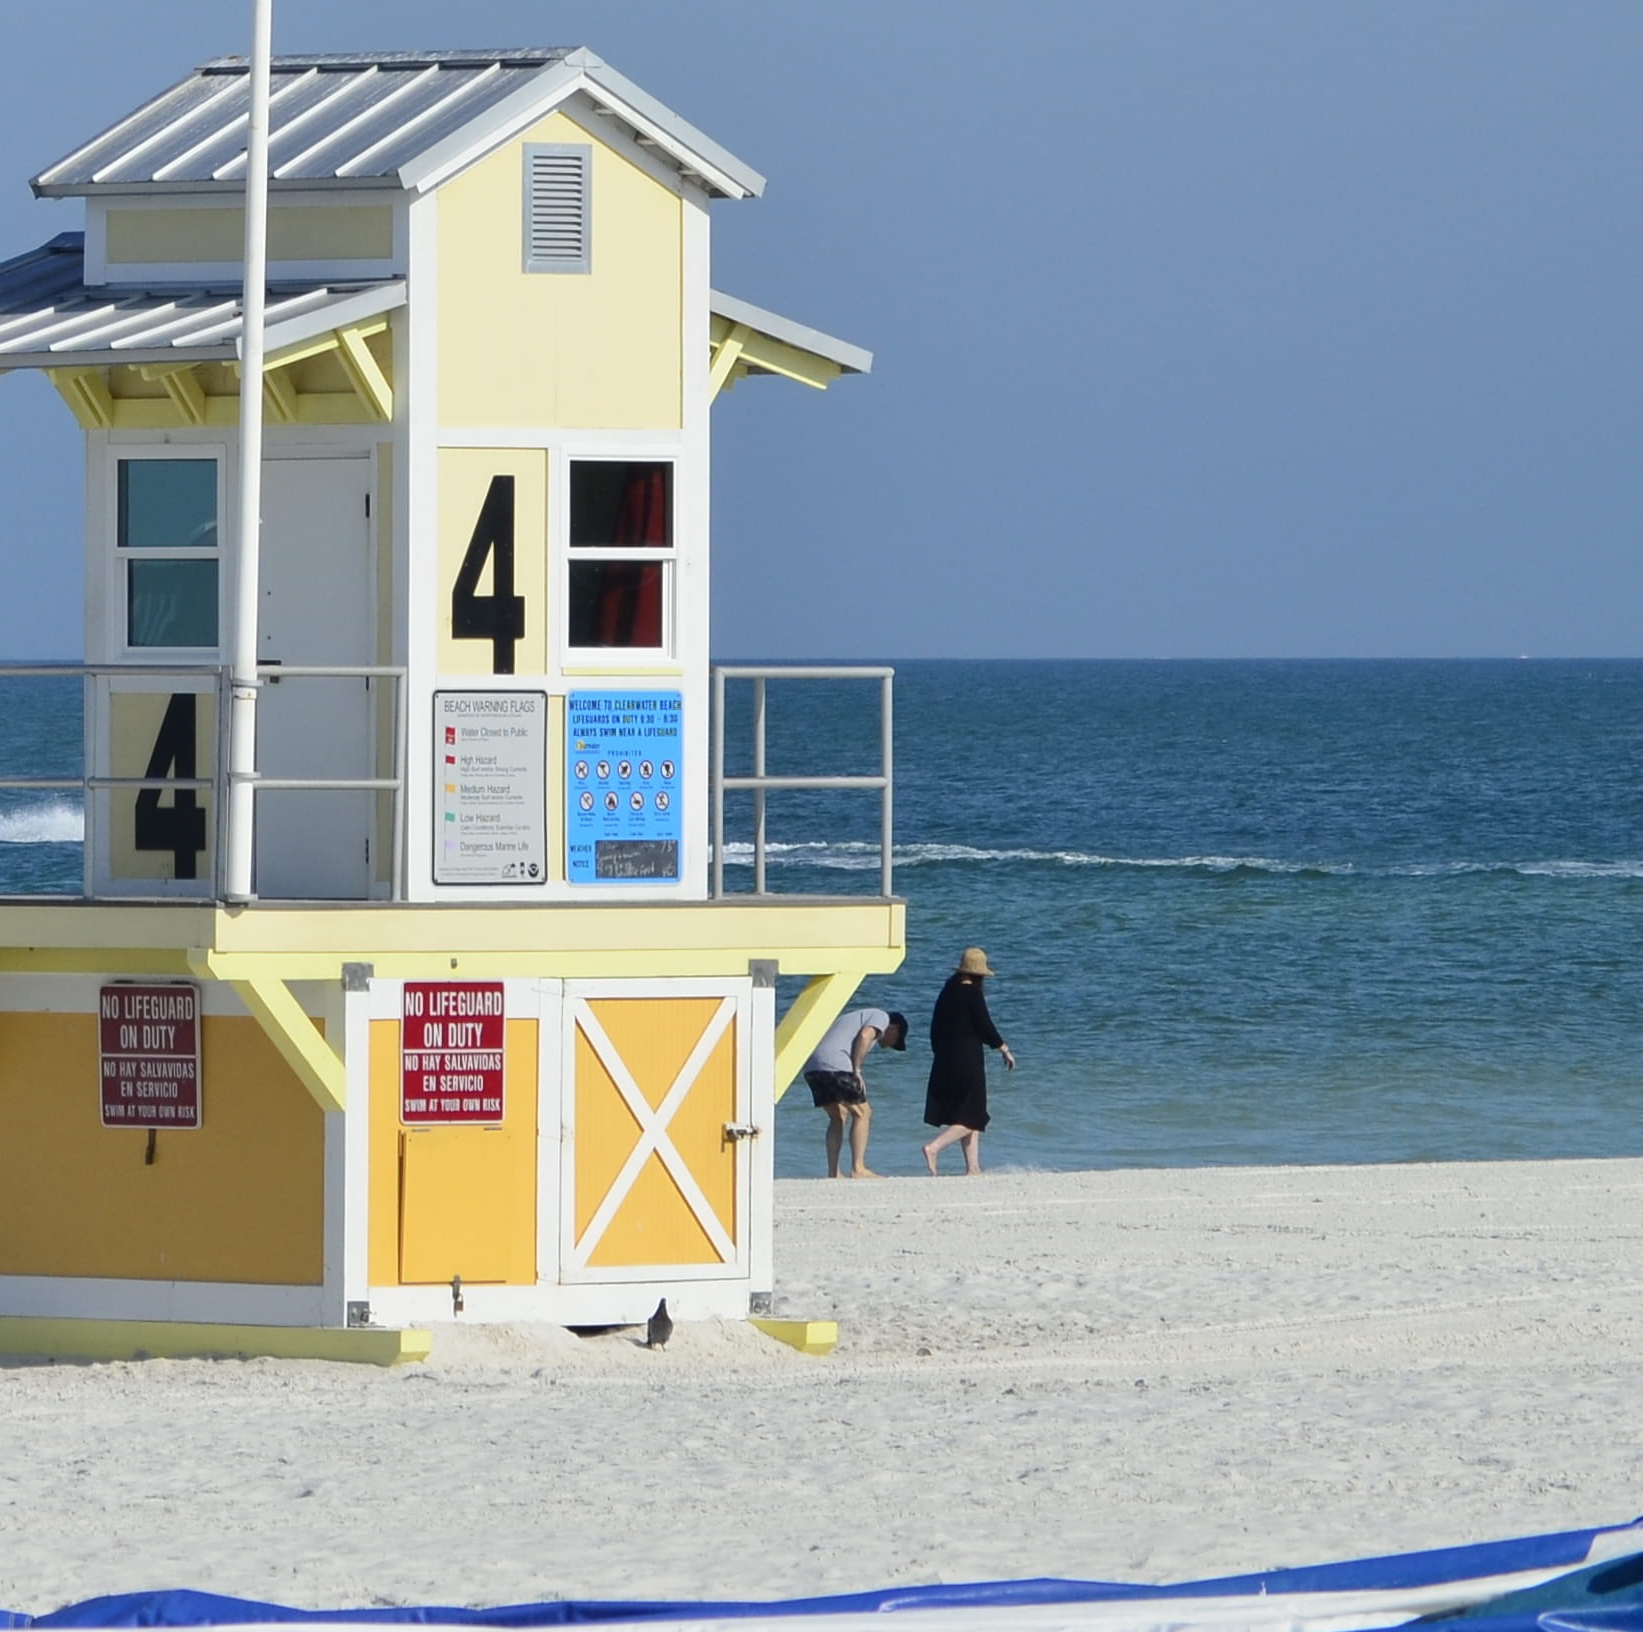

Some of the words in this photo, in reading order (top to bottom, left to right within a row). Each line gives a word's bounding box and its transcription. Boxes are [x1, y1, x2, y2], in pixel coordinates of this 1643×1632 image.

[452, 475, 525, 675] 4
[444, 700, 471, 712] BEACH
[472, 700, 508, 712] WARNING
[510, 700, 535, 712] FLAGS
[569, 700, 601, 711] WELCOME
[604, 700, 612, 711] TO
[614, 700, 657, 711] CLEARWATER
[660, 700, 681, 711] BEACH
[573, 715, 609, 724] LIFEGUARDS
[612, 715, 620, 724] ON
[622, 715, 638, 724] DUTY
[573, 728, 597, 736] ALWAYS
[599, 728, 617, 736] SWIM
[619, 728, 635, 736] NEAR
[638, 728, 642, 736] A
[644, 728, 677, 736] LIFEGUARD
[135, 693, 206, 879] 4
[102, 995, 119, 1019] NO
[125, 995, 193, 1020] LIFEGUARD
[405, 992, 424, 1016] NO
[429, 992, 502, 1016] LIFEGUARD
[120, 1025, 137, 1049] ON
[143, 1025, 175, 1049] DUTY
[424, 1023, 442, 1047] ON
[448, 1023, 483, 1047] DUTY
[103, 1061, 116, 1077] NO
[119, 1062, 137, 1078] HAY
[140, 1062, 194, 1079] SALVAVIDAS
[405, 1054, 419, 1071] NO
[422, 1054, 441, 1071] HAY
[444, 1054, 501, 1071] SALVAVIDAS
[121, 1082, 133, 1097] EN
[136, 1082, 178, 1098] SERVICIO
[423, 1075, 436, 1092] EN
[440, 1075, 484, 1092] SERVICIO
[105, 1105, 125, 1117] SWIM
[127, 1106, 136, 1117] AT
[138, 1106, 156, 1117] YOUR
[159, 1106, 176, 1118] OWN
[178, 1106, 195, 1118] RISK
[405, 1098, 426, 1112] SWIM
[429, 1098, 439, 1112] AT
[441, 1098, 460, 1112] YOUR
[462, 1098, 480, 1112] OWN
[483, 1098, 501, 1112] RISK
